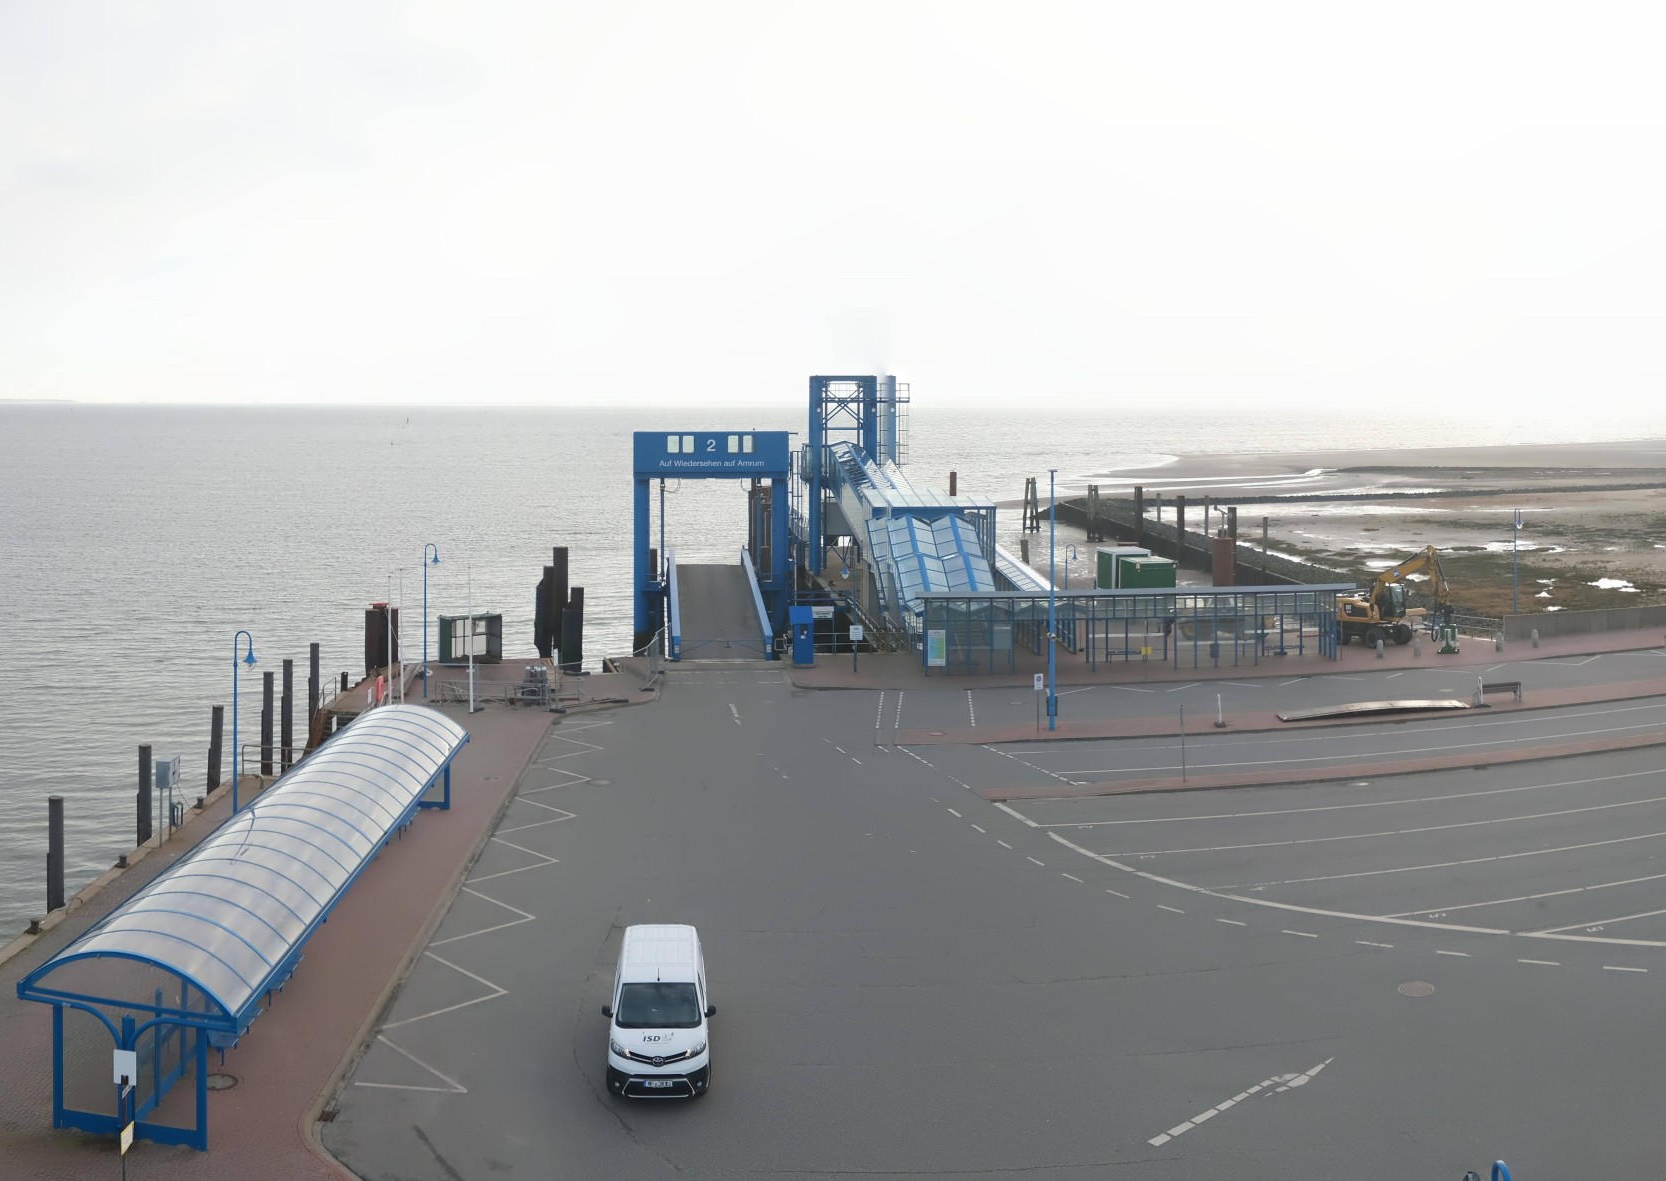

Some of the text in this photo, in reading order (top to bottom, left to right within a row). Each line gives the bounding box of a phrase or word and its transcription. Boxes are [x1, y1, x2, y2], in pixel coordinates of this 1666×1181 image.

[706, 438, 716, 452] 2
[659, 459, 765, 467] Auf Wiedersehen auf Amrum
